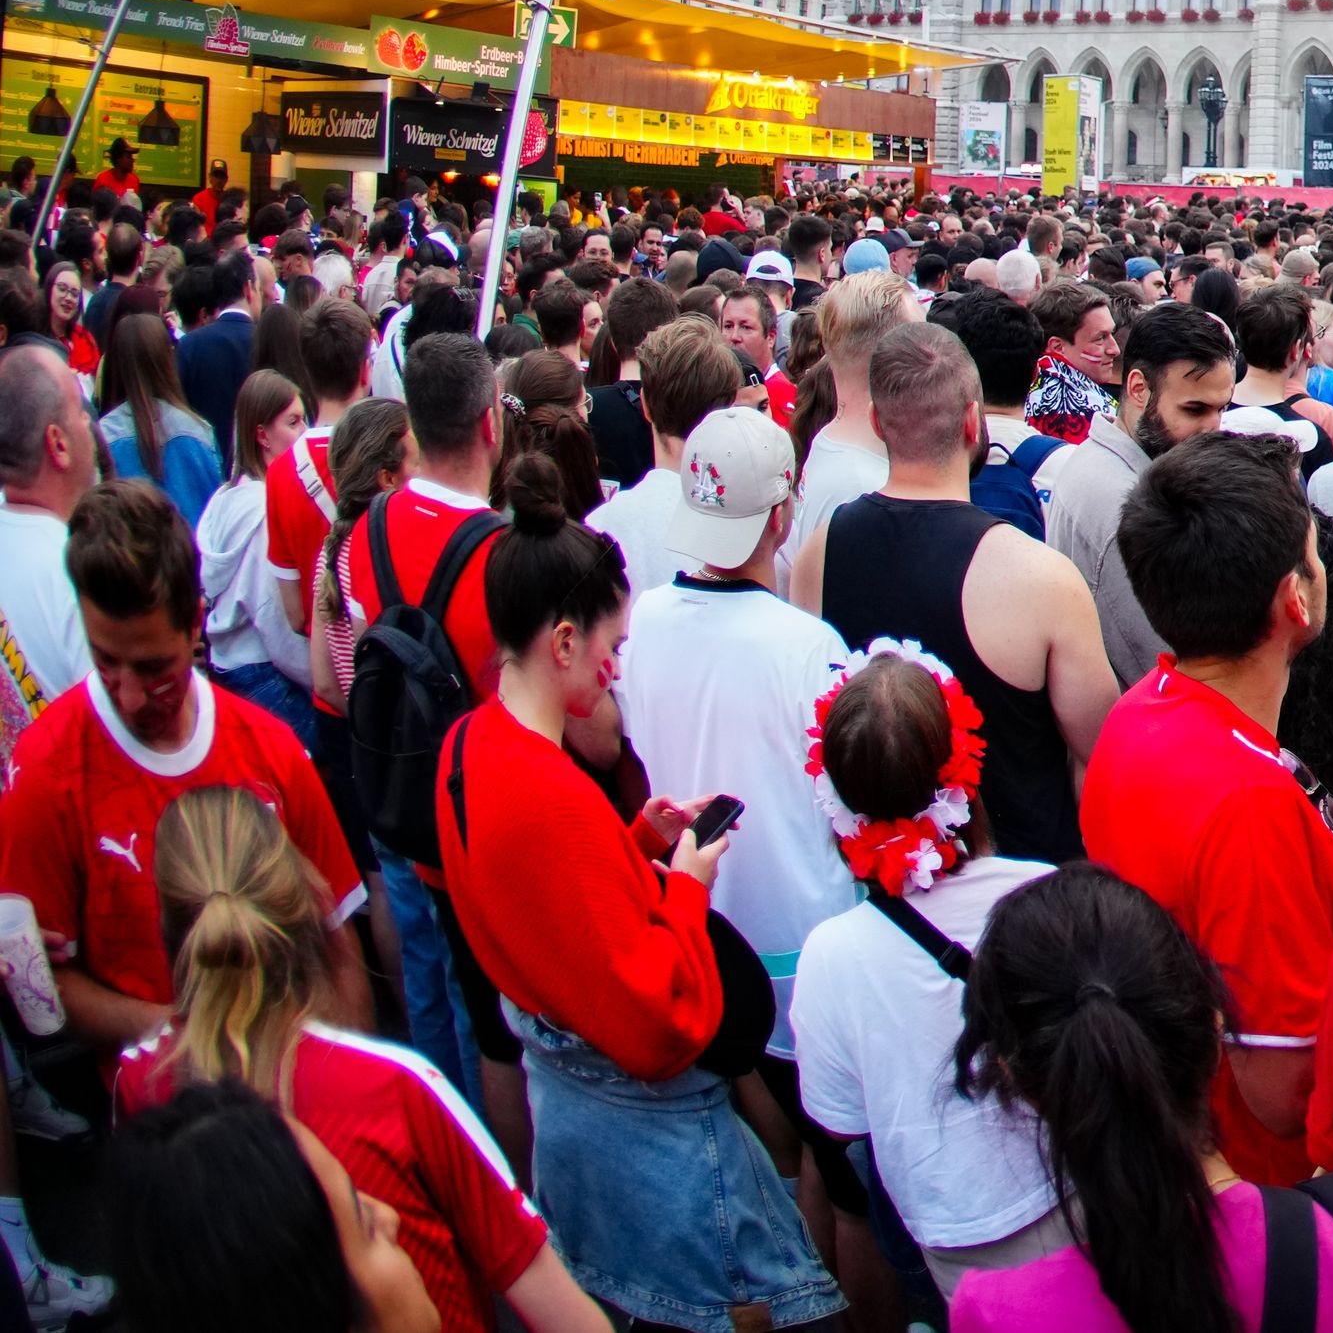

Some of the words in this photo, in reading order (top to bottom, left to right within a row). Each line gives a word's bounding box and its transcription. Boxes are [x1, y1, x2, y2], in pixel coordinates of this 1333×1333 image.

[184, 16, 205, 32] Fries
[242, 25, 271, 41] Wiener
[271, 30, 306, 47] Schnitzel
[434, 54, 509, 79] Himbeer-Spritzer
[480, 45, 542, 68] Erdbeer-Be
[732, 80, 820, 120] Ottakringer
[286, 107, 326, 138] Wiener
[325, 108, 379, 140] Schnitzel
[403, 123, 447, 148] Wiener
[446, 129, 499, 158] Schnitzel
[1312, 140, 1333, 150] Film
